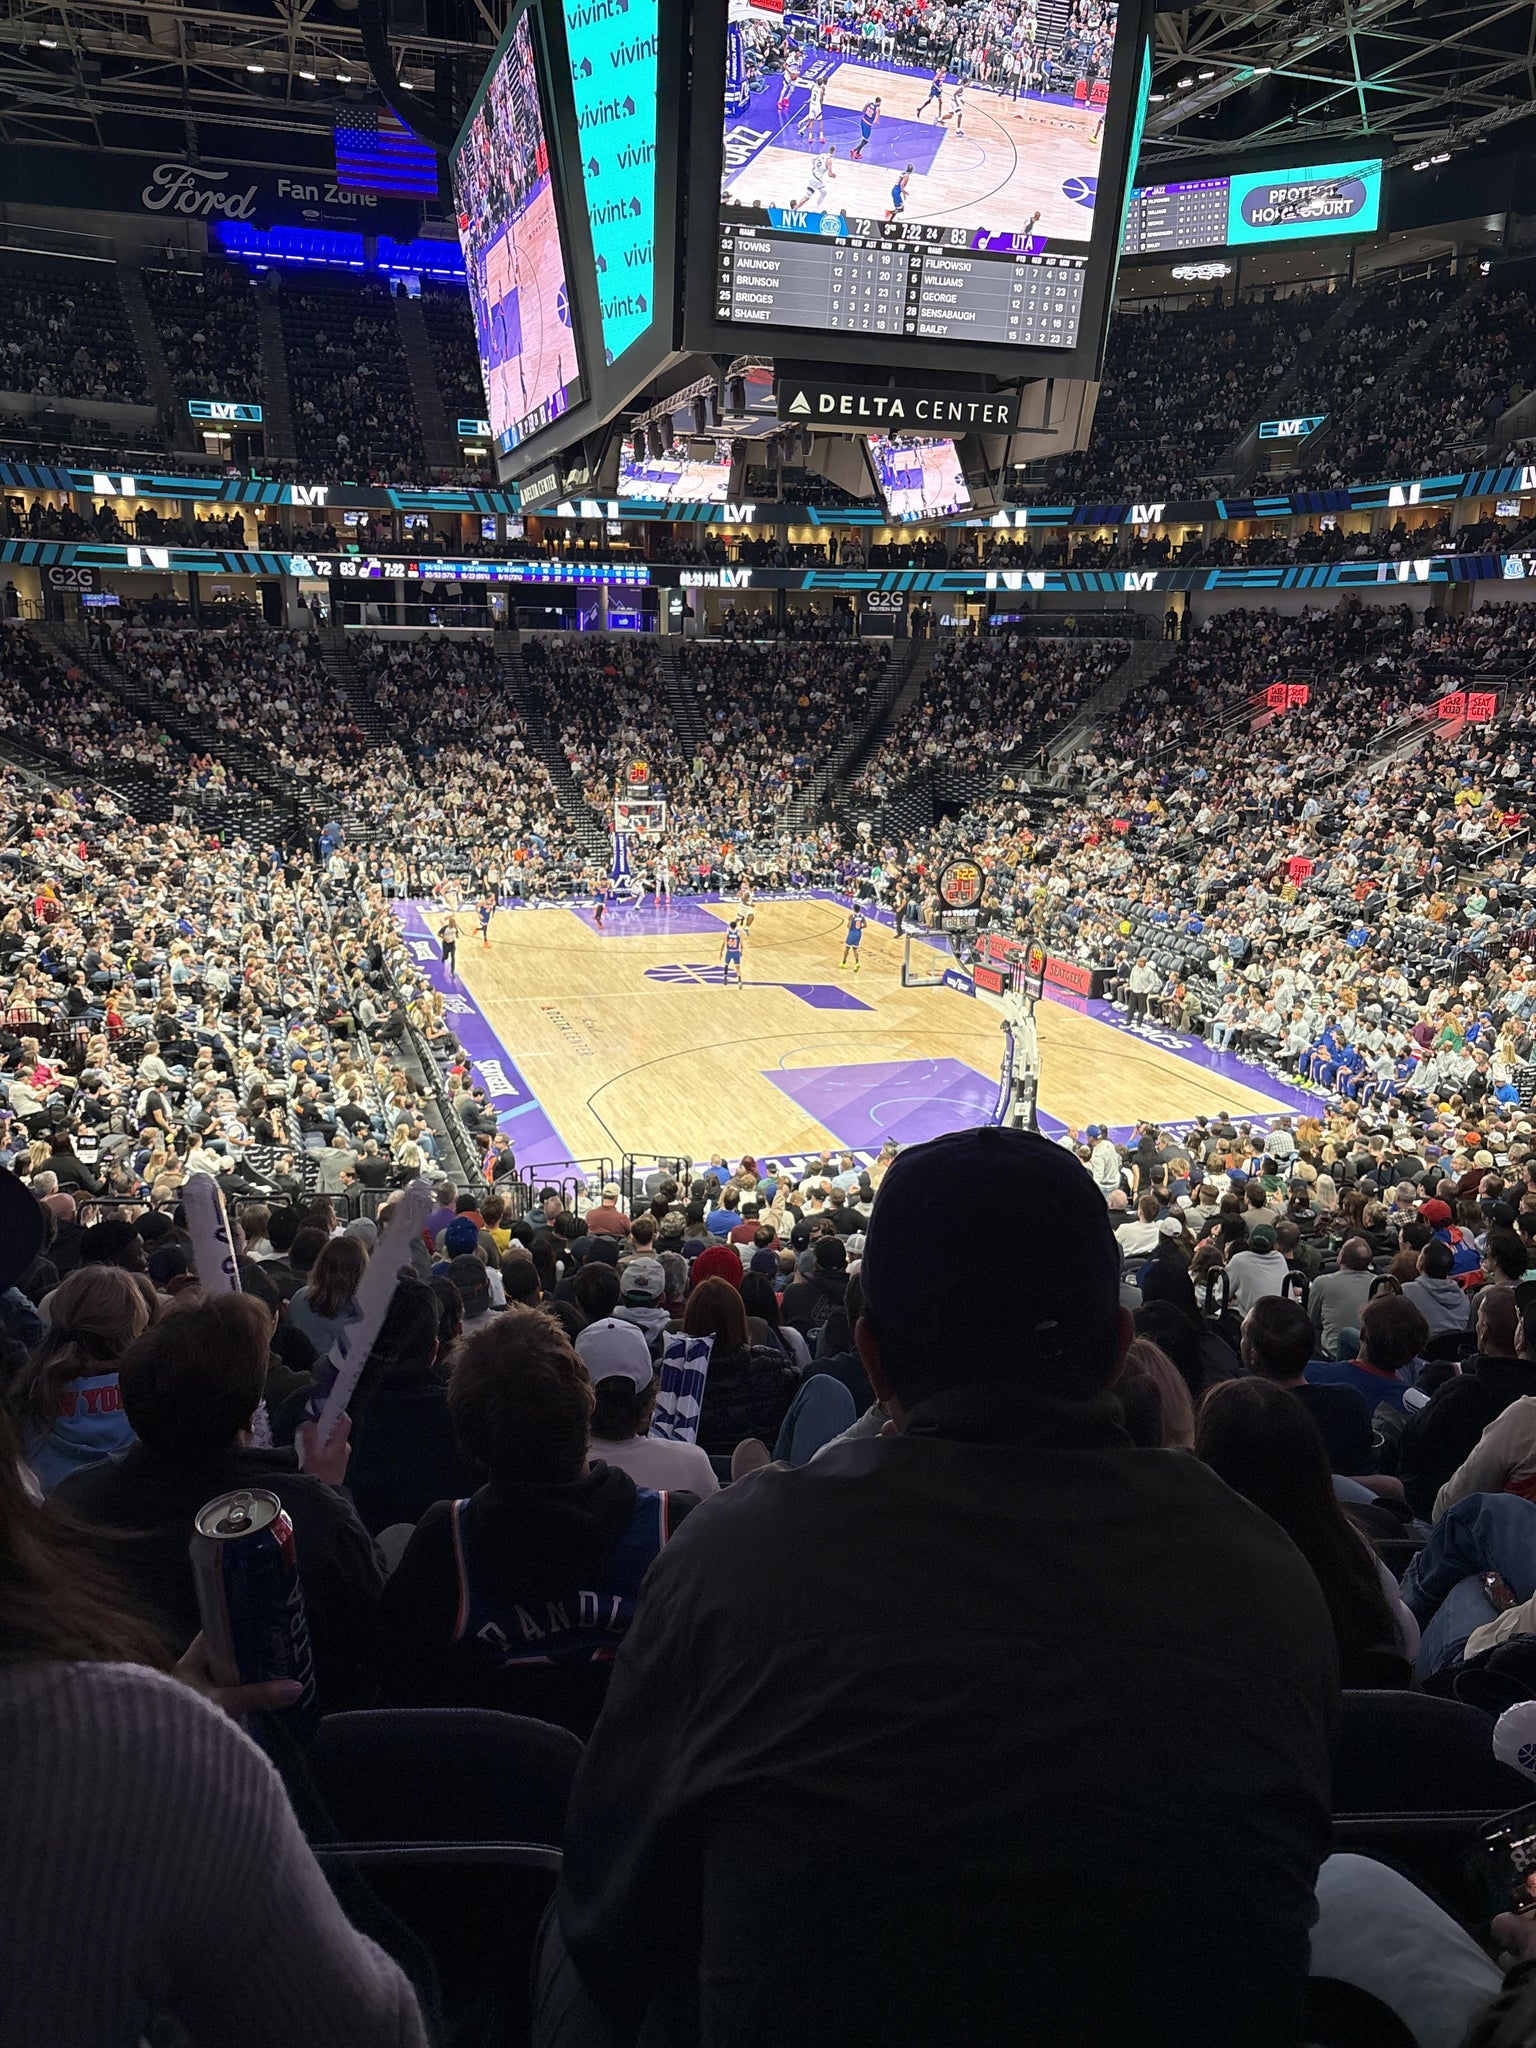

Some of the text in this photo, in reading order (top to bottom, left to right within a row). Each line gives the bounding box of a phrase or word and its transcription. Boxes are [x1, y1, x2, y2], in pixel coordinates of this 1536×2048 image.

[616, 139, 656, 170] vivin
[141, 163, 258, 219] Ford
[277, 178, 319, 200] Fan
[782, 211, 808, 228] NYK
[739, 228, 756, 237] NAME
[866, 241, 877, 249] AST
[855, 219, 871, 235] 72
[901, 223, 922, 240] 7:22
[926, 229, 938, 239] 24
[951, 229, 967, 244] 83
[1011, 234, 1034, 250] UTA
[721, 239, 903, 266] 32 TOWNS 17 5 4 19 1
[927, 246, 943, 256] NAME
[1046, 258, 1057, 266] AST
[723, 256, 903, 282] 8 ANUNOBY 12 2 1 20 2
[910, 258, 1080, 282] 22 FILIPOWSKI 10 7 4 13 3
[722, 273, 900, 299] 11 BRUNSON 17 2 4 23 1
[911, 274, 1077, 298] 5 WILLIAMS 10 2 2 23 1
[720, 290, 899, 315] 25 BRIDGES 5 3 2 21 1
[910, 290, 1076, 314] 3 GEORGE 12 2 5 18 1
[718, 307, 898, 331] 44 SHAMET 2 2 2 18 1
[906, 307, 1074, 330] 28 SENSABAUGH 18 3 4 16 3
[905, 323, 1073, 345] 19 BAILEY 15 3 2 23 2
[819, 393, 1009, 424] DELTA CENTER
[1278, 419, 1302, 437] LVT
[291, 485, 328, 506] LVT
[523, 473, 557, 503] DELTA CENTER
[723, 504, 756, 523] LVT
[1131, 504, 1166, 523] LVT
[49, 567, 93, 586] G2G
[315, 562, 331, 576] 72
[340, 562, 356, 576] 83
[384, 563, 405, 577] 7:22
[704, 571, 718, 587] PM
[720, 566, 753, 588] LVT
[1124, 572, 1158, 591] LVT
[866, 591, 904, 607] G2G
[630, 769, 646, 783] 24
[953, 868, 977, 880] 7:22
[947, 880, 973, 901] 24
[515, 900, 597, 911] JAZZ
[952, 909, 979, 917] TISSOT
[1049, 962, 1084, 988] SEATGEEK
